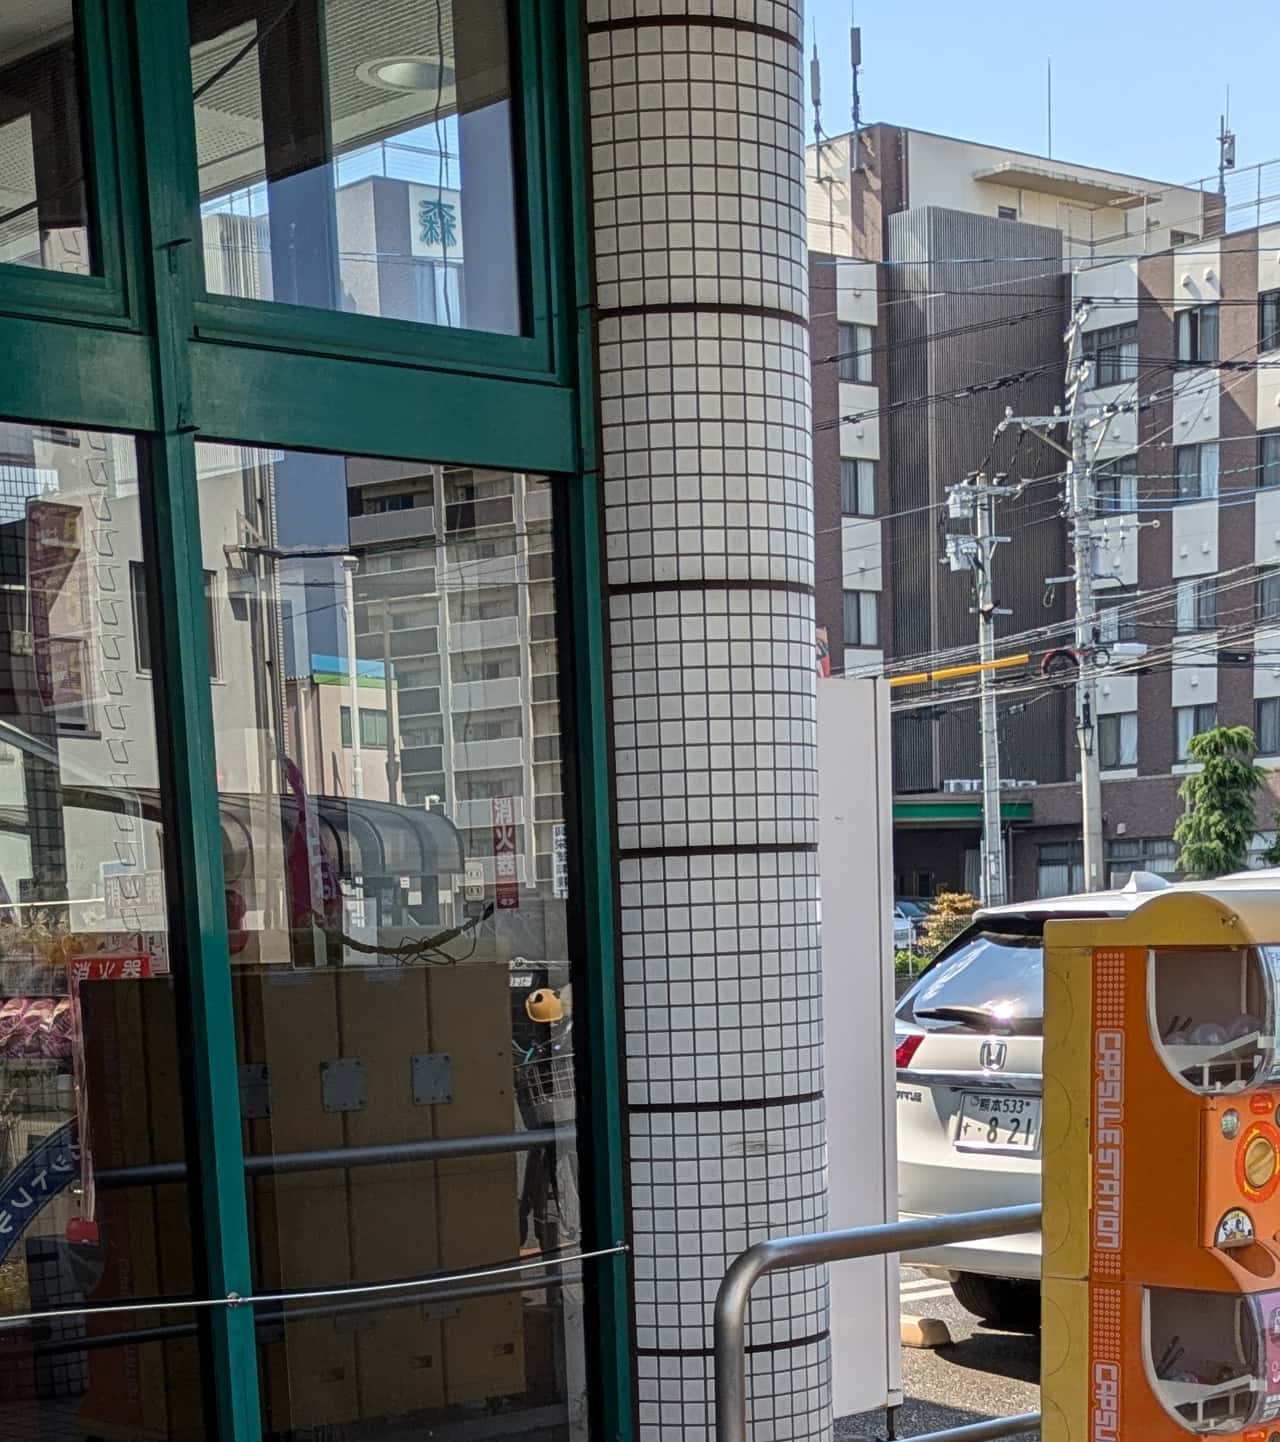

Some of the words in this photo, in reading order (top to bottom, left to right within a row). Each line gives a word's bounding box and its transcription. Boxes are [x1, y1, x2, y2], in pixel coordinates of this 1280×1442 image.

[494, 799, 515, 876] 消火器
[73, 960, 142, 980] 消火器
